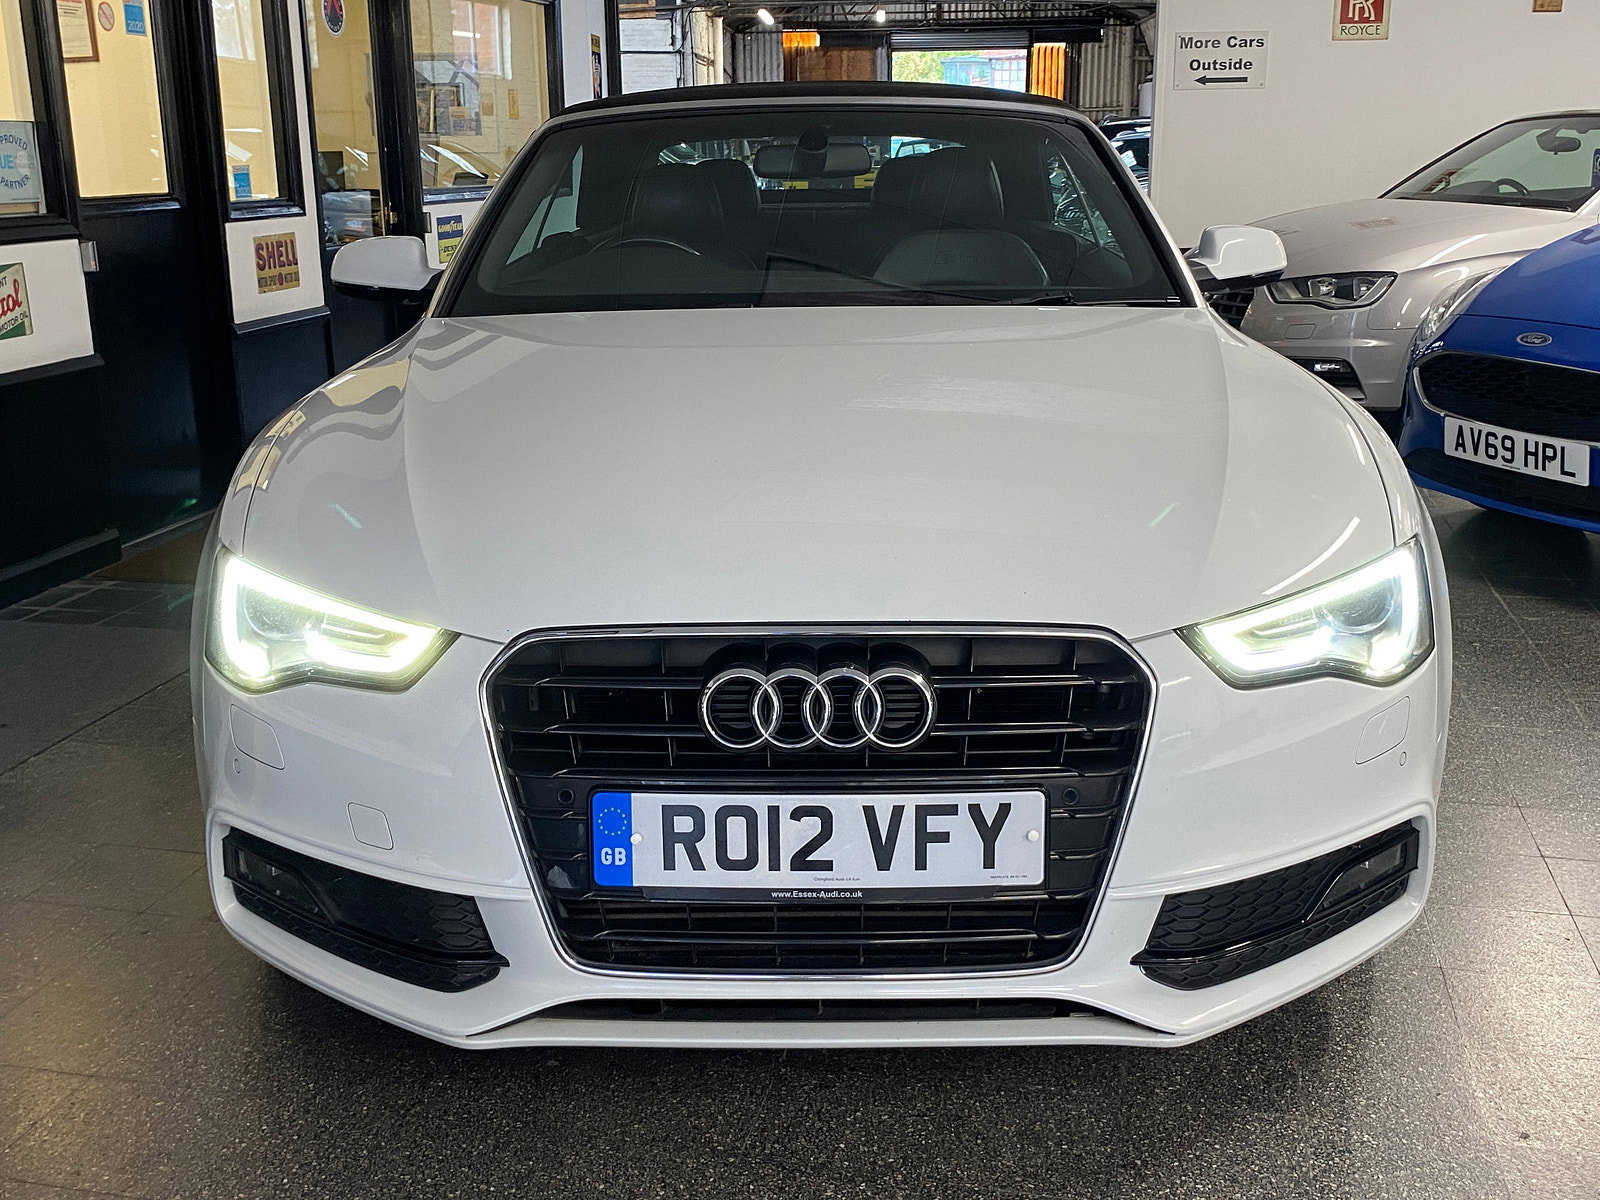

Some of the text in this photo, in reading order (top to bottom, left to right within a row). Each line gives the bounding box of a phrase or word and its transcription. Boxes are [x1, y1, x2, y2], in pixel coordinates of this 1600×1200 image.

[1340, 25, 1381, 36] ROYCE
[1180, 36, 1265, 49] More Cars
[1189, 58, 1253, 71] Outside
[0, 174, 31, 190] PARTNER
[255, 239, 298, 271] SHELL
[19, 311, 29, 321] OIL
[1454, 424, 1577, 479] AV69 HPL
[661, 802, 1012, 872] RO12 VFY
[600, 847, 626, 866] GB
[771, 890, 863, 899] www.Essex-Audi.co.uk
